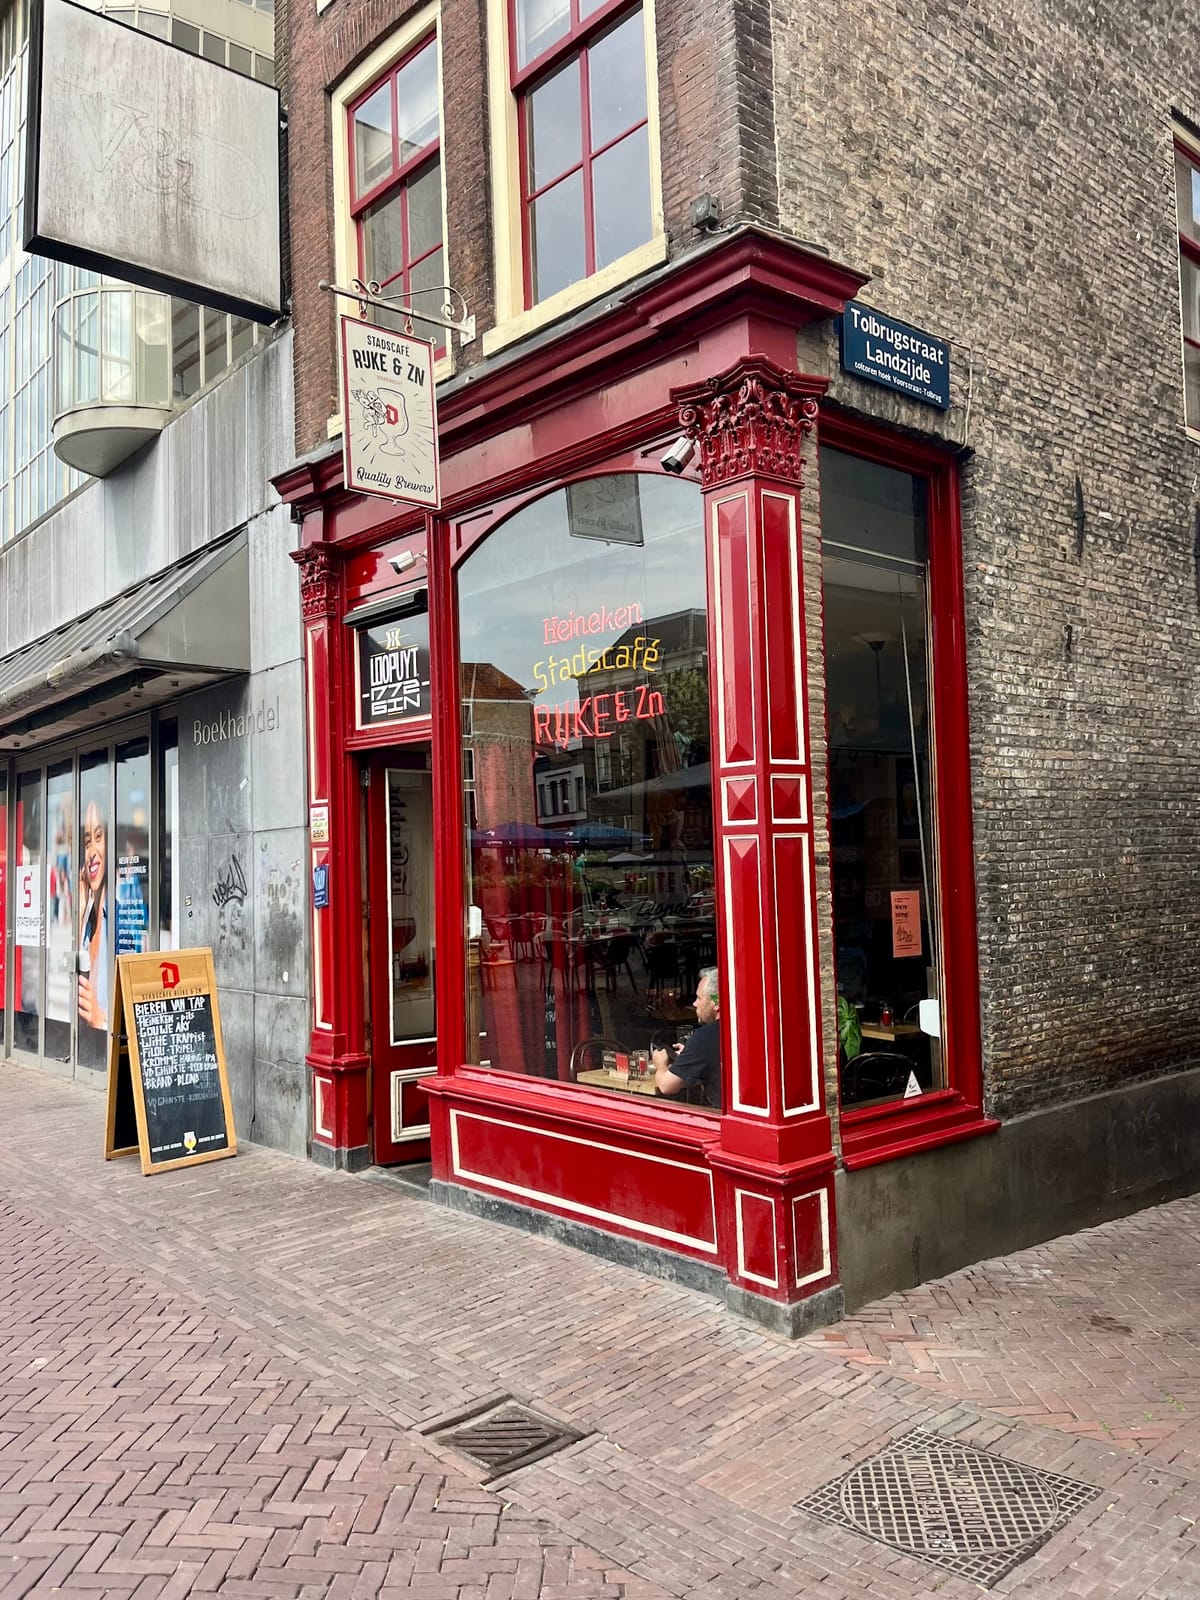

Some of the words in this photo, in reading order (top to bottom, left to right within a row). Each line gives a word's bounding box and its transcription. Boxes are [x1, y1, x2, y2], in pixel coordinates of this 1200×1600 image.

[850, 308, 944, 365] Tolbrugstraat
[352, 349, 387, 372] RIJKE
[393, 357, 402, 375] &
[407, 363, 425, 387] ZN
[866, 341, 931, 384] Landzijde
[878, 369, 892, 382] hoek
[356, 466, 392, 488] Quality
[394, 475, 434, 494] Brewers
[543, 600, 644, 645] Heineken
[533, 636, 661, 693] Stadscafé
[193, 695, 280, 746] Boekhandel
[371, 693, 421, 716] GIN
[533, 694, 612, 749] RIJKE
[615, 690, 630, 722] &
[635, 684, 665, 719] Zn
[135, 1001, 167, 1016] BIEREN
[187, 996, 205, 1009] TAP
[140, 1024, 173, 1038] GOUWE
[146, 1075, 173, 1090] BRAND
